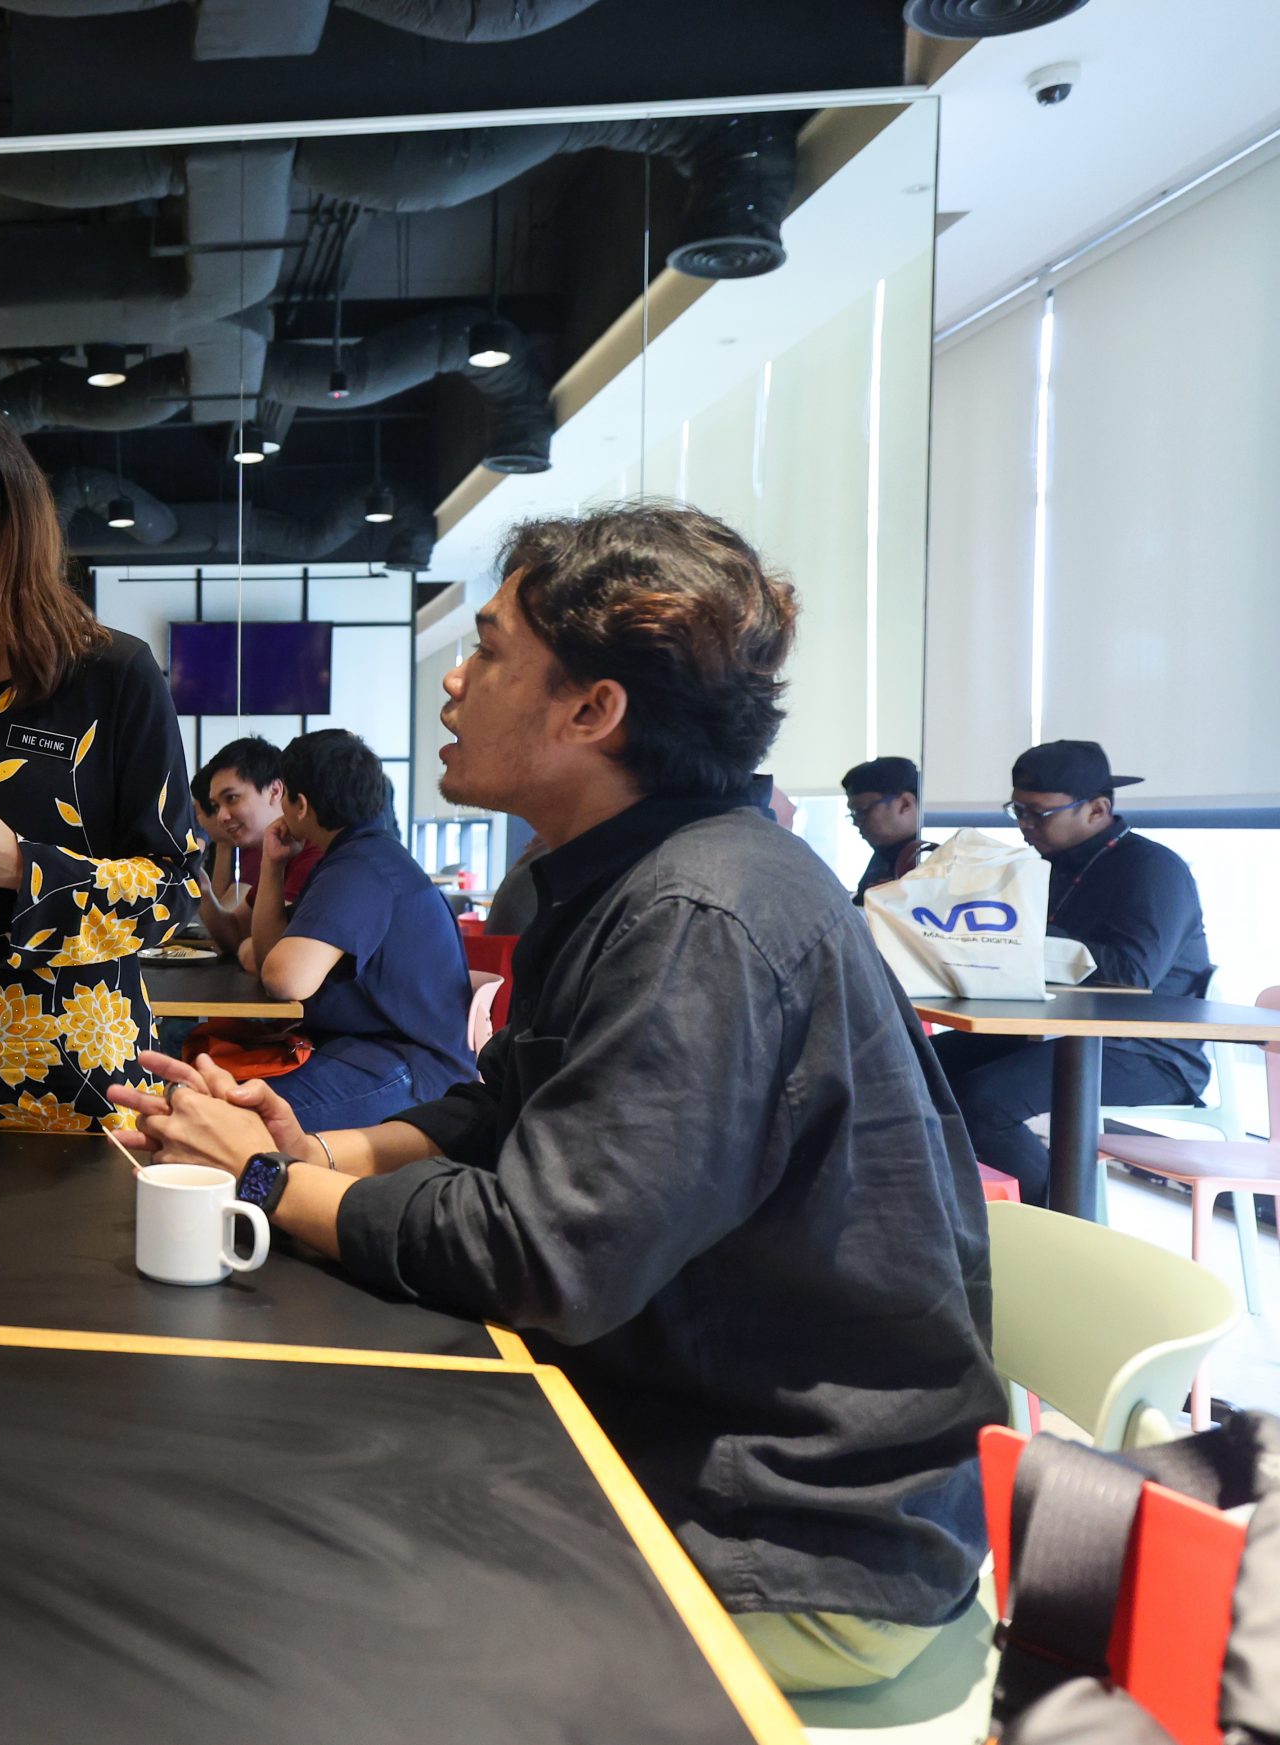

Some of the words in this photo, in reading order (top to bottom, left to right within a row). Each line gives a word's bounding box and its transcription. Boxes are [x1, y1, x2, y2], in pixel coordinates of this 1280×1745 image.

[21, 734, 38, 746] NIE
[39, 738, 65, 752] CHING
[923, 931, 979, 943] MALSIA
[981, 936, 1023, 946] DIGITAL
